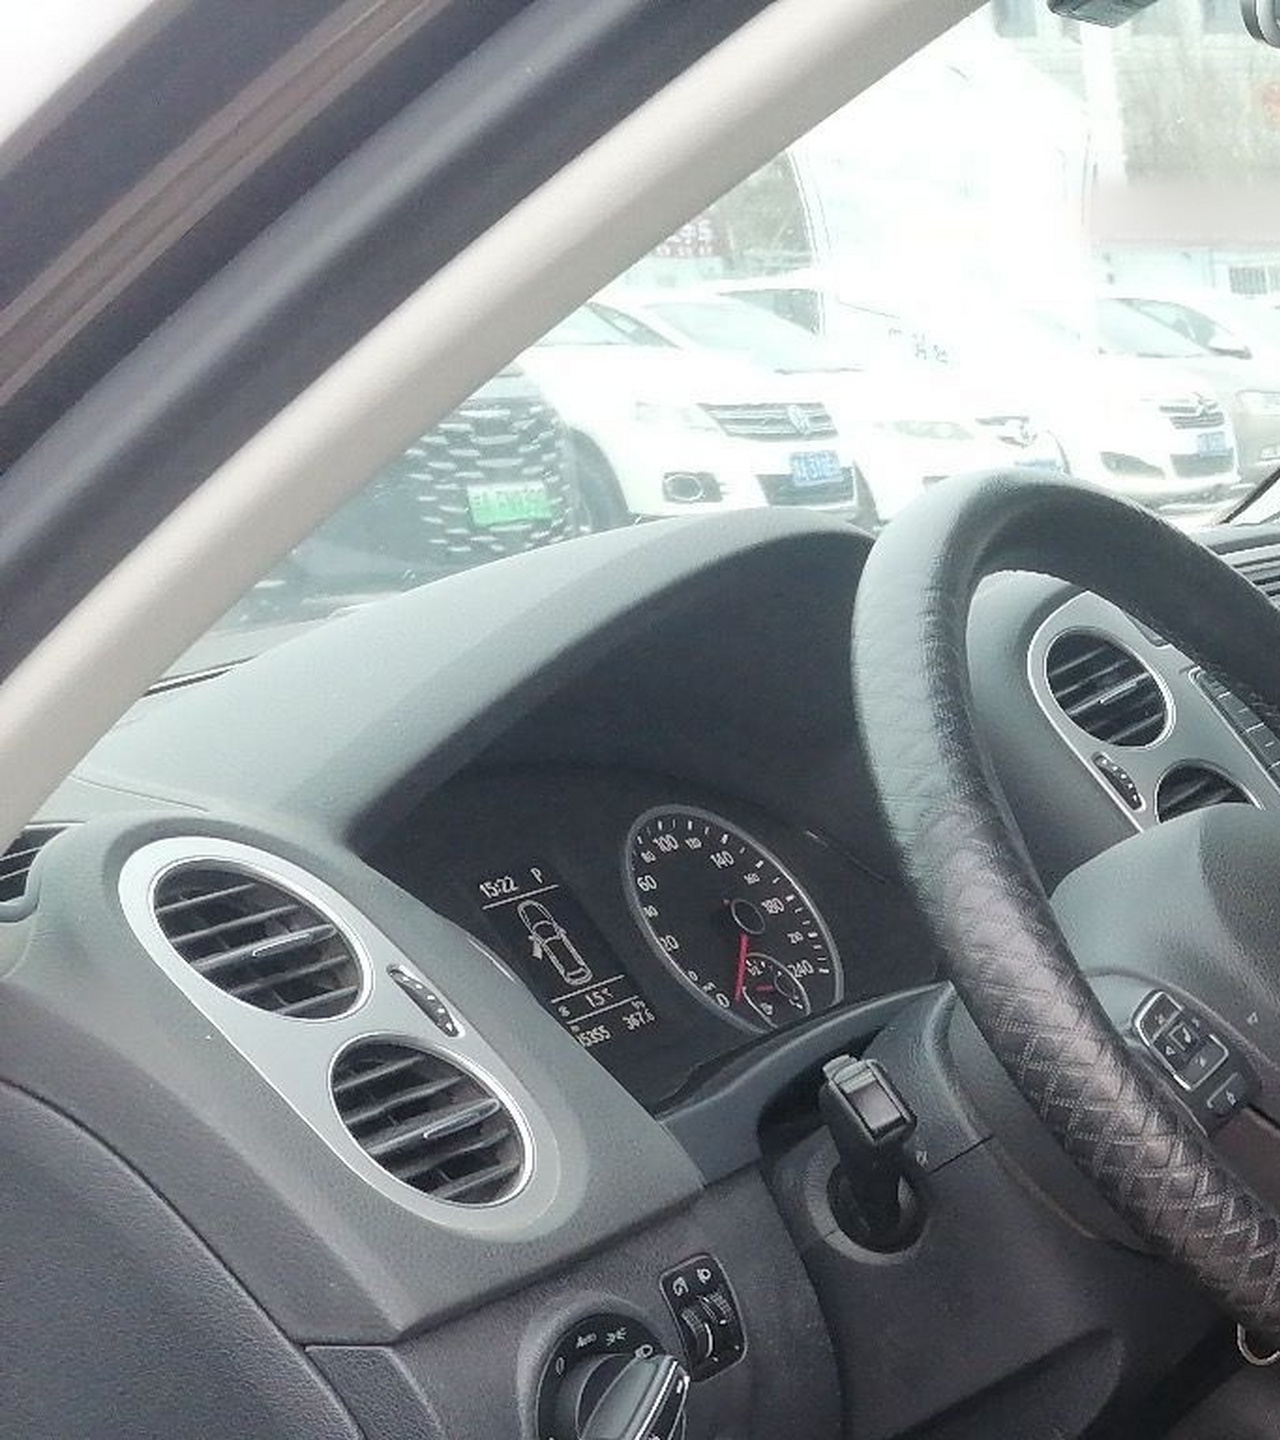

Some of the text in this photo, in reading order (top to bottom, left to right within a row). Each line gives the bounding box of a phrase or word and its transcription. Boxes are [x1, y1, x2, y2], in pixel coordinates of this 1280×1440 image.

[653, 833, 679, 853] 100
[710, 850, 734, 869] 140
[478, 867, 544, 899] 15:22 P
[636, 874, 657, 892] 60
[761, 897, 785, 915] 180
[786, 959, 814, 979] 240
